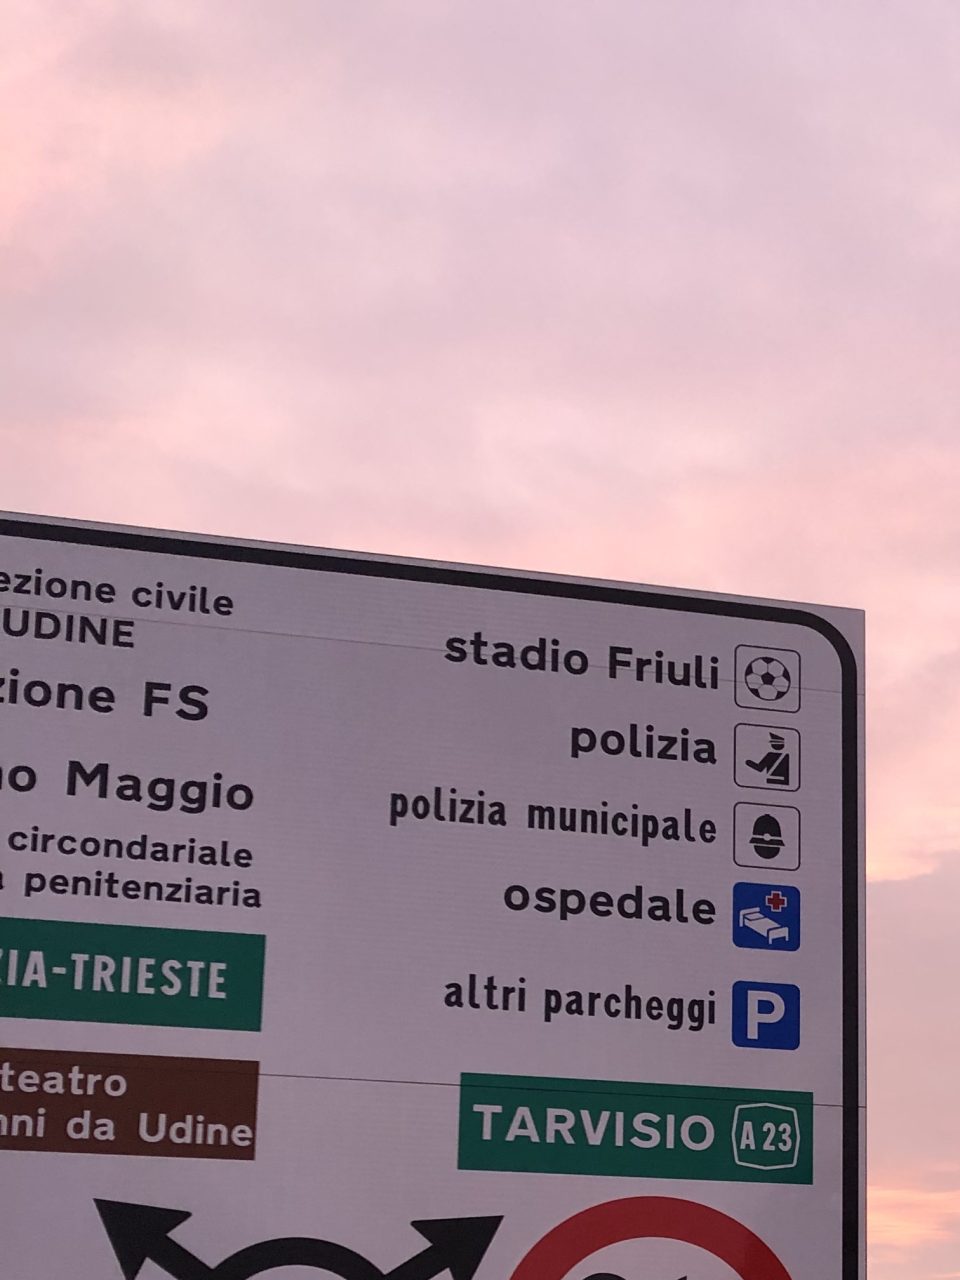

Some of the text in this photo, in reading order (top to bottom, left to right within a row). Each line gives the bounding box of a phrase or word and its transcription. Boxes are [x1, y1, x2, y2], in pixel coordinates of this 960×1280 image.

[132, 582, 233, 615] civile
[3, 608, 134, 648] UDINE
[444, 632, 718, 689] stadio Friuli
[0, 668, 208, 720] ione FS
[571, 724, 717, 764] polizia
[67, 761, 253, 814] Maggio
[390, 787, 716, 846] polizia municipale
[8, 826, 252, 868] circondariale
[25, 871, 261, 908] penitenziaria
[504, 885, 715, 924] ospedale
[0, 949, 227, 999] IA-TRIESTE
[444, 974, 715, 1031] altri parcheggi
[747, 990, 785, 1039] P
[0, 1062, 127, 1096] teatro
[67, 1110, 115, 1140] da
[139, 1113, 252, 1146] Udine
[473, 1104, 714, 1150] TARVISIO
